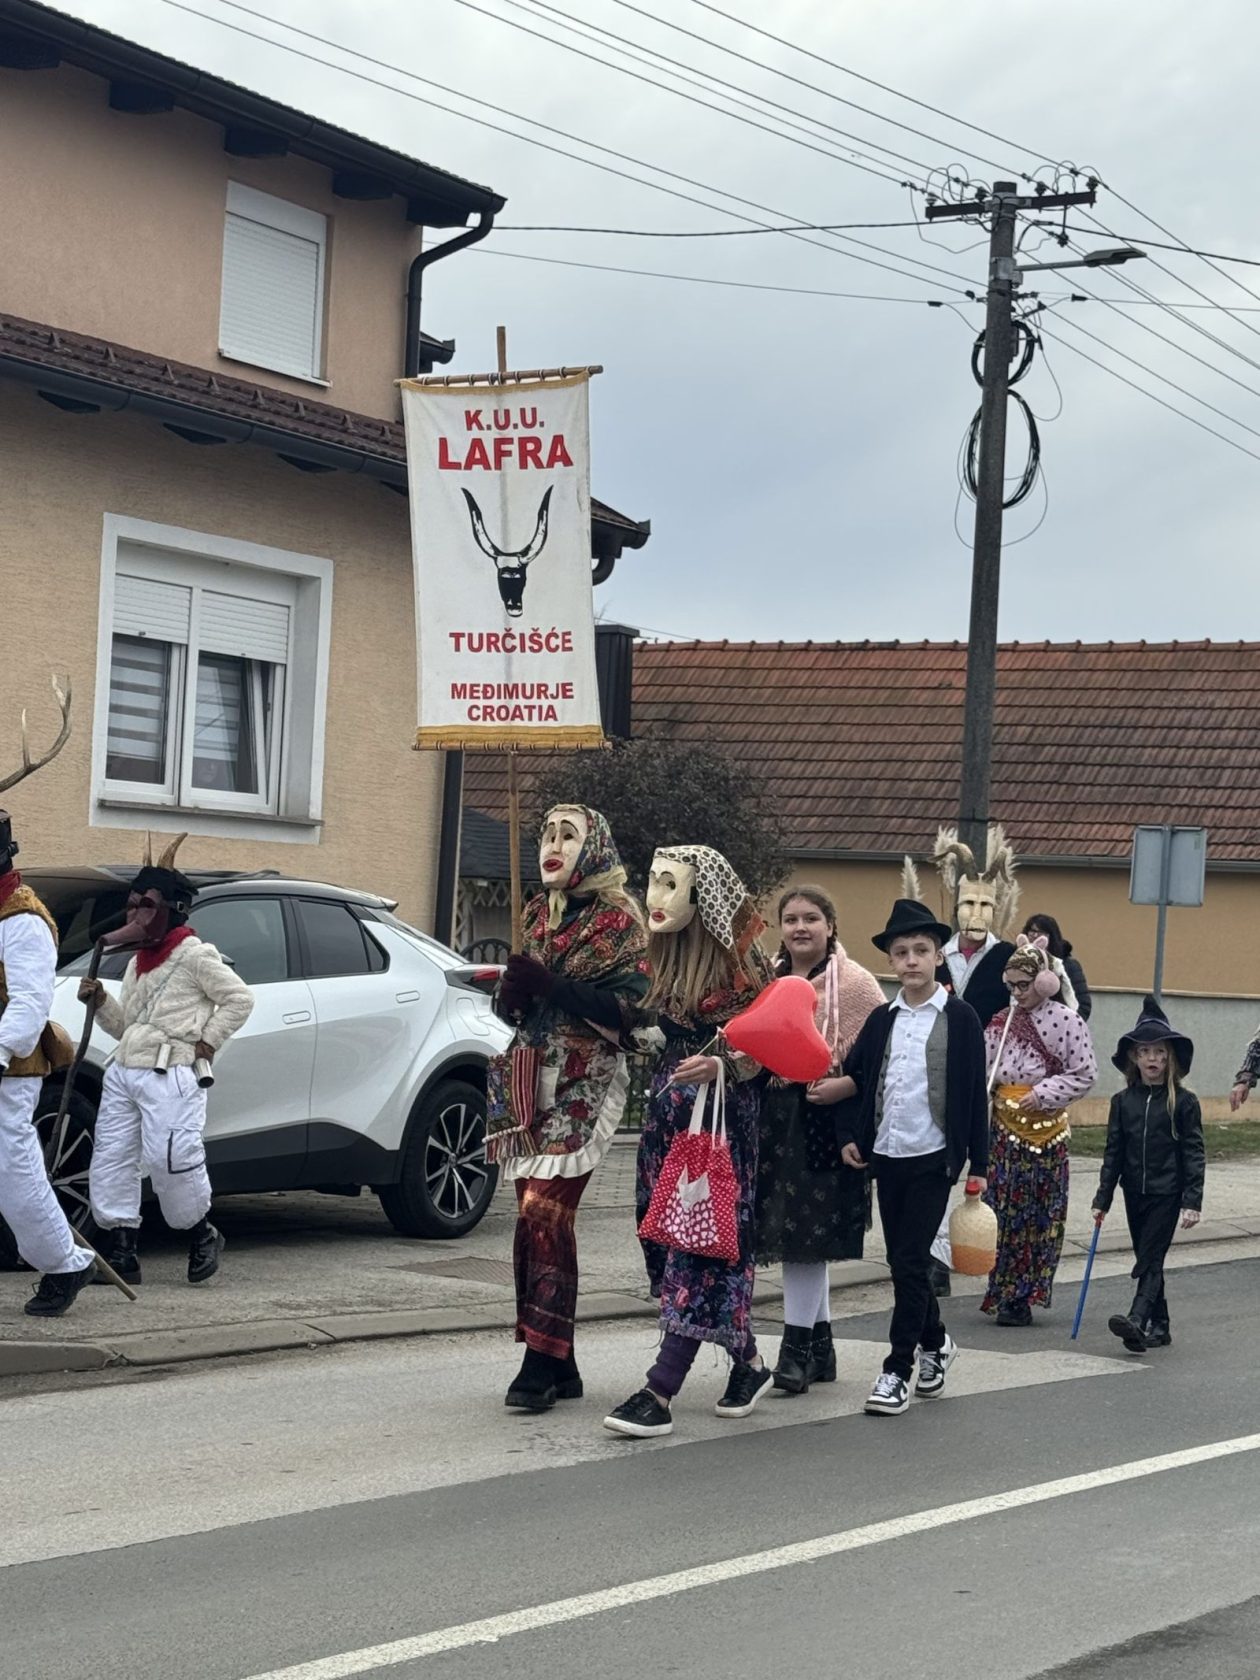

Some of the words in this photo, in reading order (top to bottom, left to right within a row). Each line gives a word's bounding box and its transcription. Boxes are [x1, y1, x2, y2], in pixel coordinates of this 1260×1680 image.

[465, 408, 545, 430] K.U.U.
[438, 434, 573, 471] LAFRA
[449, 627, 573, 653] TURČIŠĆE
[451, 682, 574, 700] MEĐIMURJE
[467, 704, 558, 722] CROATIA
